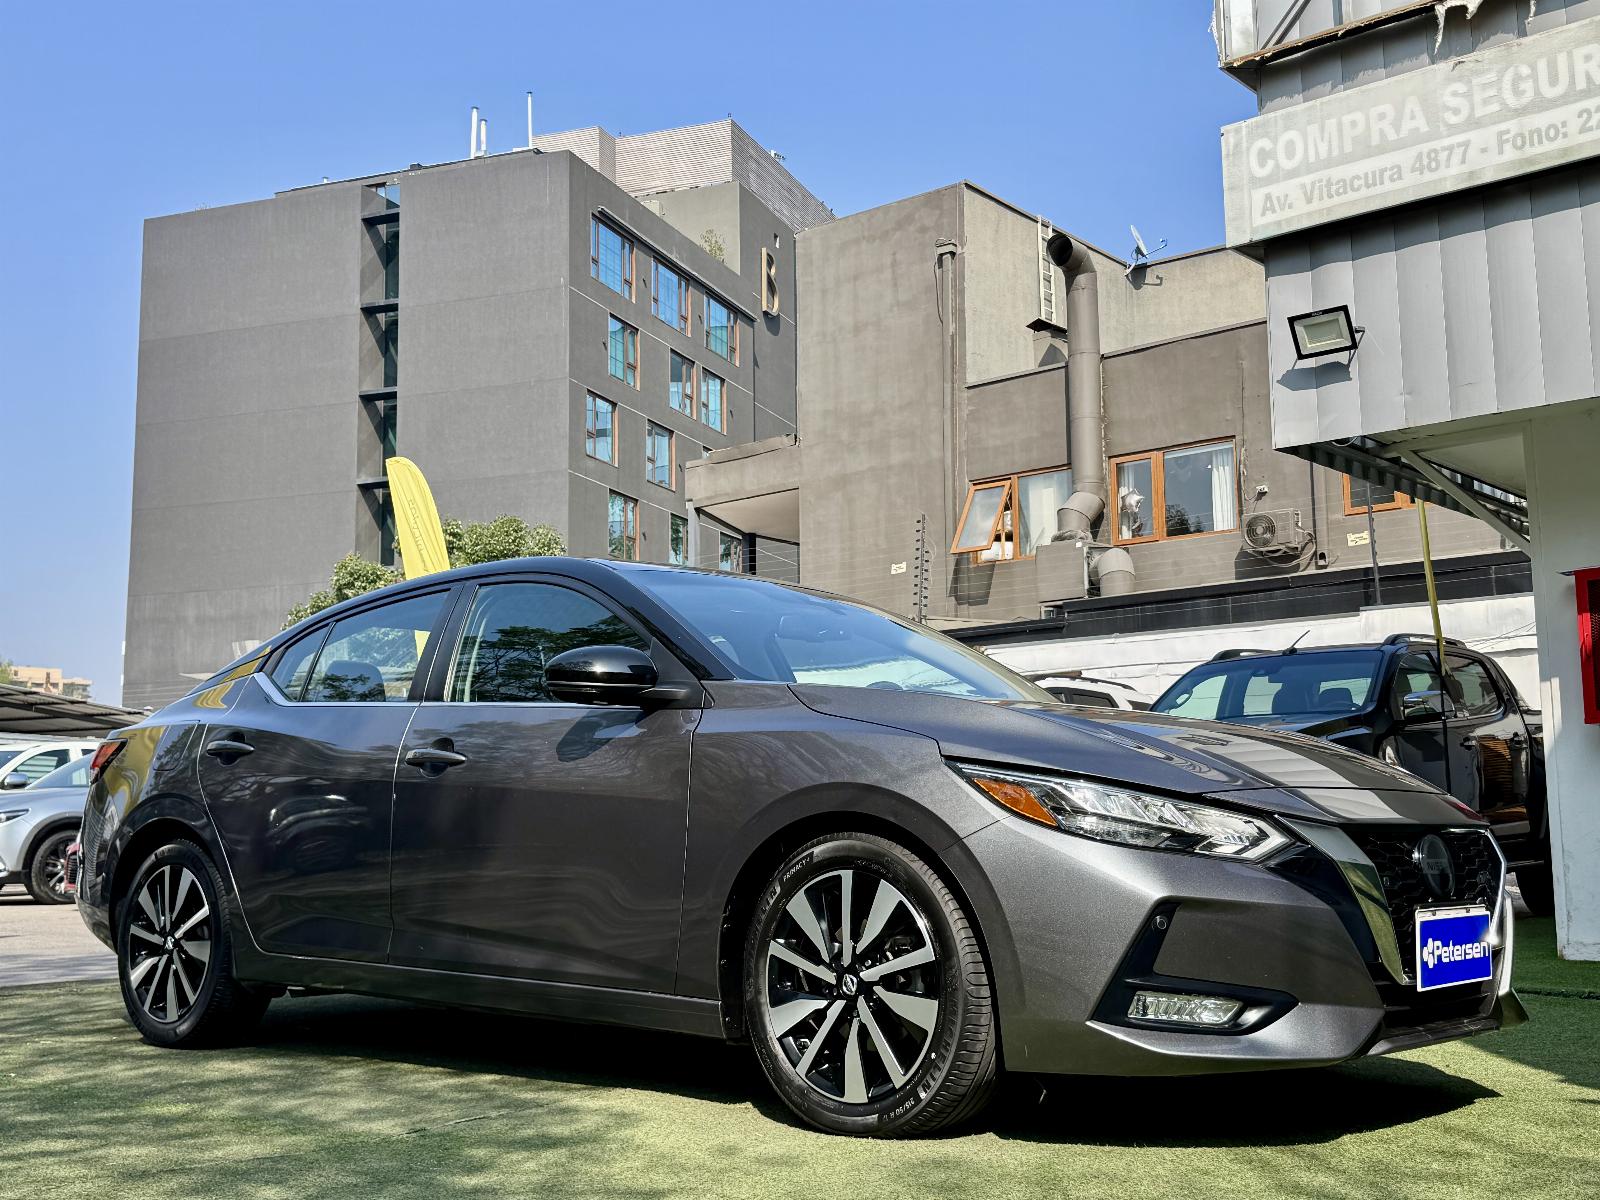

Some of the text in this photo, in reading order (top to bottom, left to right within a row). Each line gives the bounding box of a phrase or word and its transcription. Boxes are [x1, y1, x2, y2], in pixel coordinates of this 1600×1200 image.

[1250, 43, 1600, 179] COMPRA SEGUR
[1260, 192, 1294, 217] Av.
[1302, 163, 1404, 205] Vitacura
[1410, 140, 1472, 177] 4877
[1497, 120, 1569, 156] Fono:
[761, 247, 780, 317] B
[783, 858, 807, 882] PRIMACY
[1433, 940, 1489, 965] Petersen
[895, 1097, 915, 1115] 215/50
